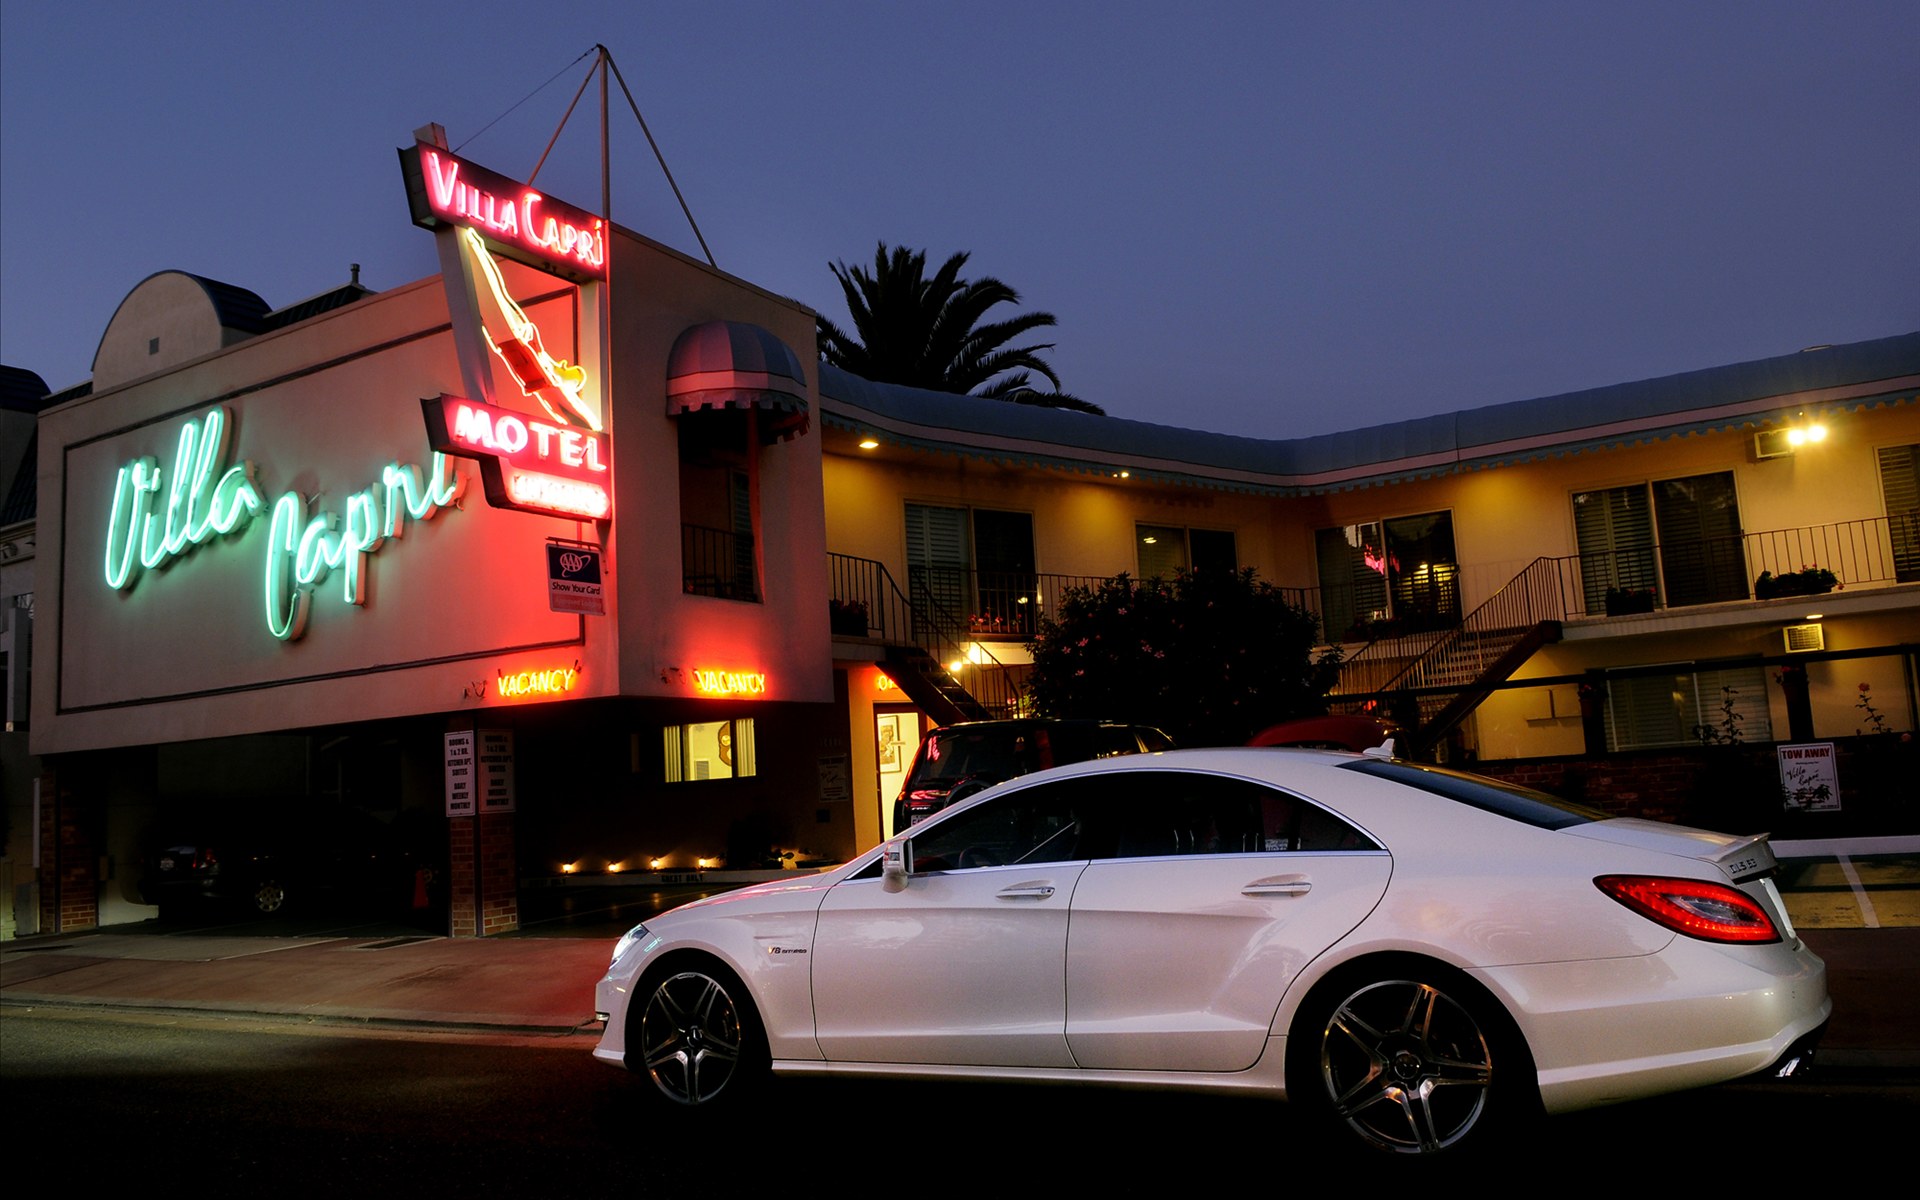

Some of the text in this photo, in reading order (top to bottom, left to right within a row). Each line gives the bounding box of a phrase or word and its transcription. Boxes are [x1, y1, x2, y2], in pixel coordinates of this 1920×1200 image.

[426, 151, 518, 237] VILLA
[454, 404, 607, 471] MOTEL
[105, 405, 263, 590] Villa
[265, 451, 460, 640] Capri
[562, 553, 582, 572] AAA
[552, 581, 600, 595] Show Your Card
[498, 668, 575, 696] VACANCY
[693, 670, 765, 693] VACANCY
[1781, 748, 1830, 759] TOW AWAY
[452, 768, 468, 776] SUITES
